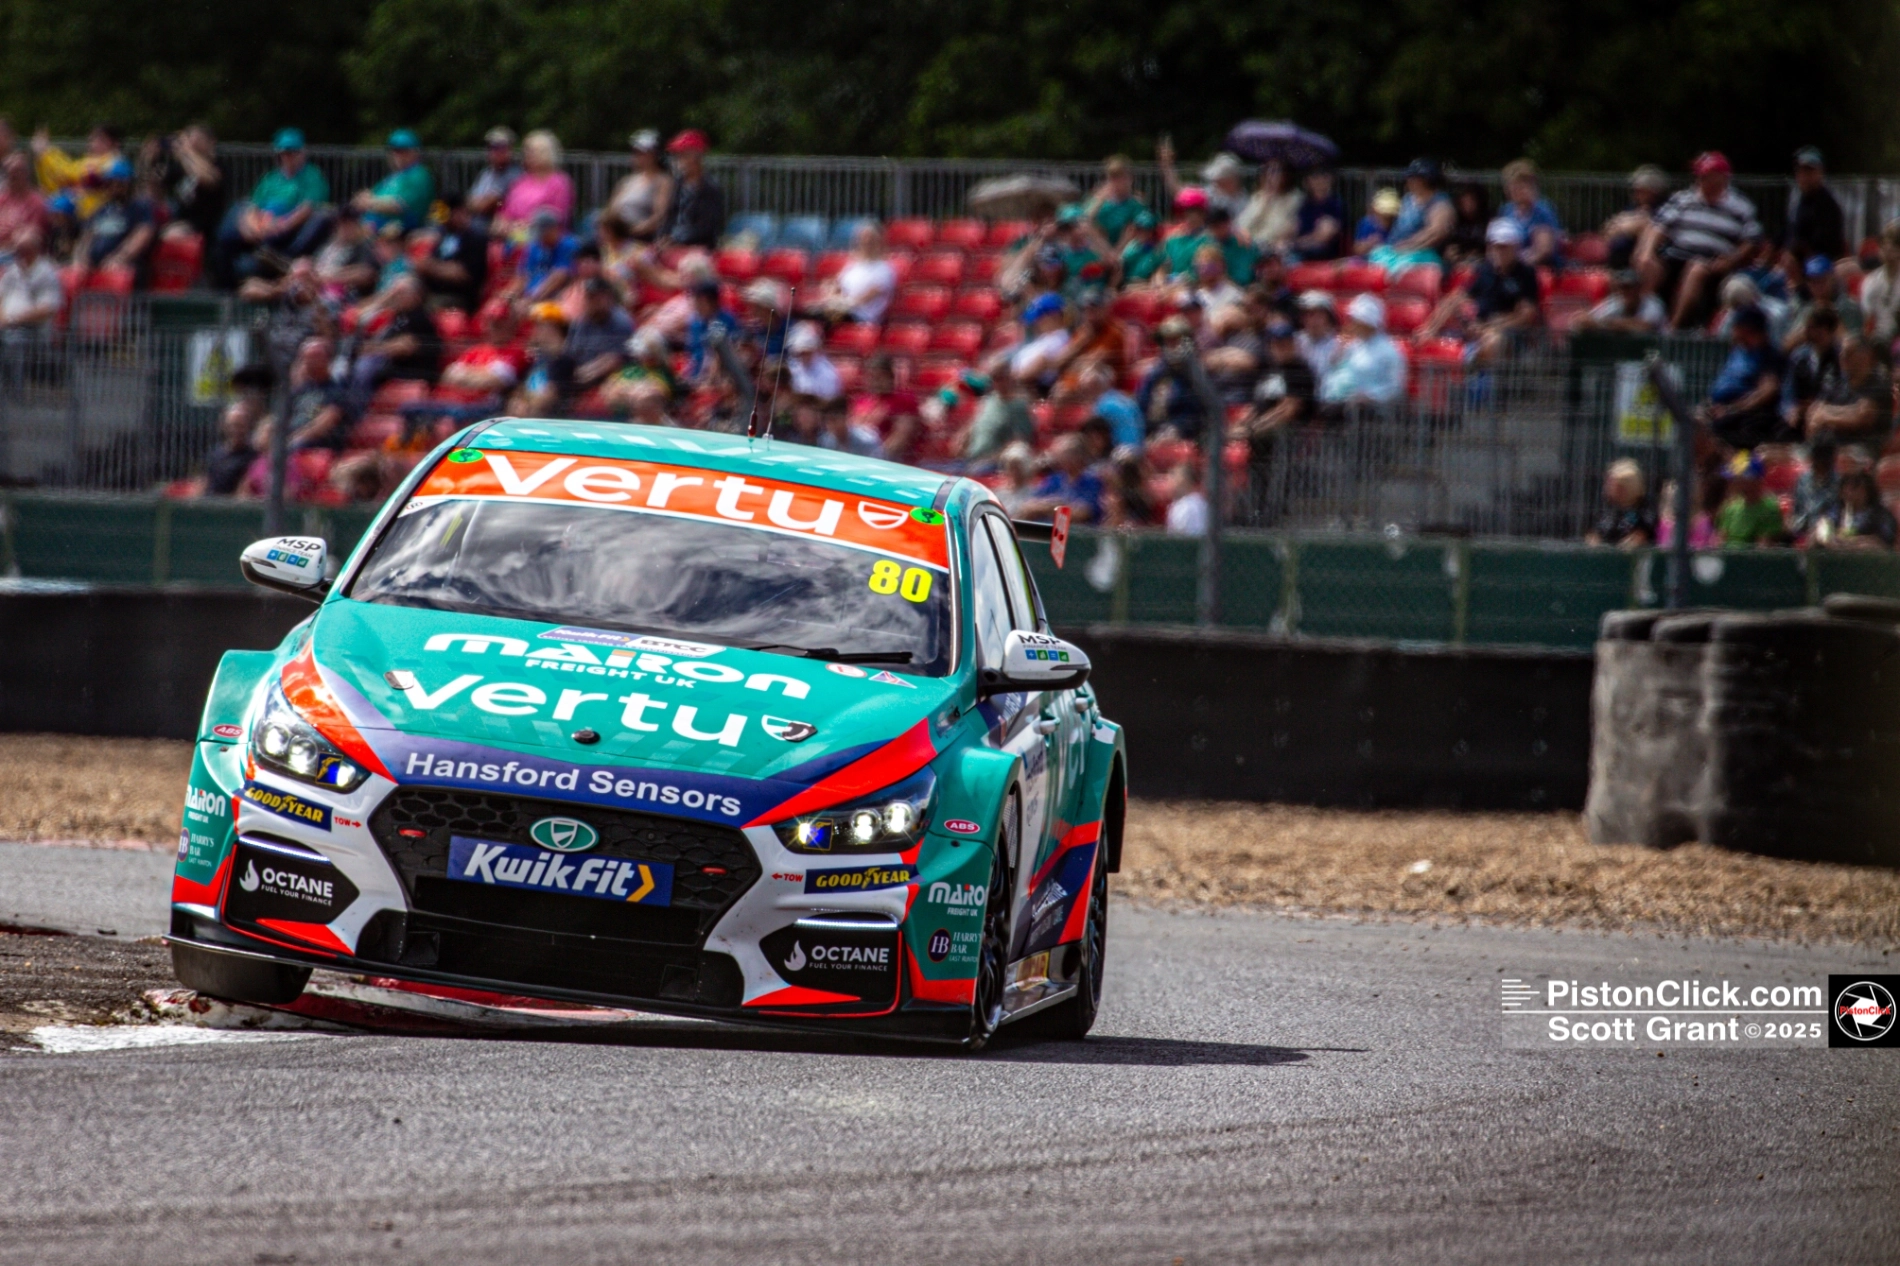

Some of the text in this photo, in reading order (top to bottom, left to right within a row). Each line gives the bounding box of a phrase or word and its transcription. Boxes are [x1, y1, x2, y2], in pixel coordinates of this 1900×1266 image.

[277, 538, 321, 551] MSP
[868, 559, 933, 603] 80
[525, 659, 698, 689] FREIGHT UK
[217, 726, 241, 736] ABS
[405, 751, 742, 817] Hansford Sensors
[244, 786, 324, 823] GOODYEAR
[334, 816, 351, 827] TOW
[949, 821, 975, 831] ABS
[262, 867, 334, 898] OCTANE
[783, 873, 804, 883] TOW
[815, 867, 910, 889] GOODYEAR
[261, 884, 333, 907] FUEL YOUR FINANCE
[947, 907, 978, 917] FREIGHT UK
[811, 945, 890, 963] OCTANE
[951, 943, 967, 954] BAR
[854, 963, 888, 972] FINANCE
